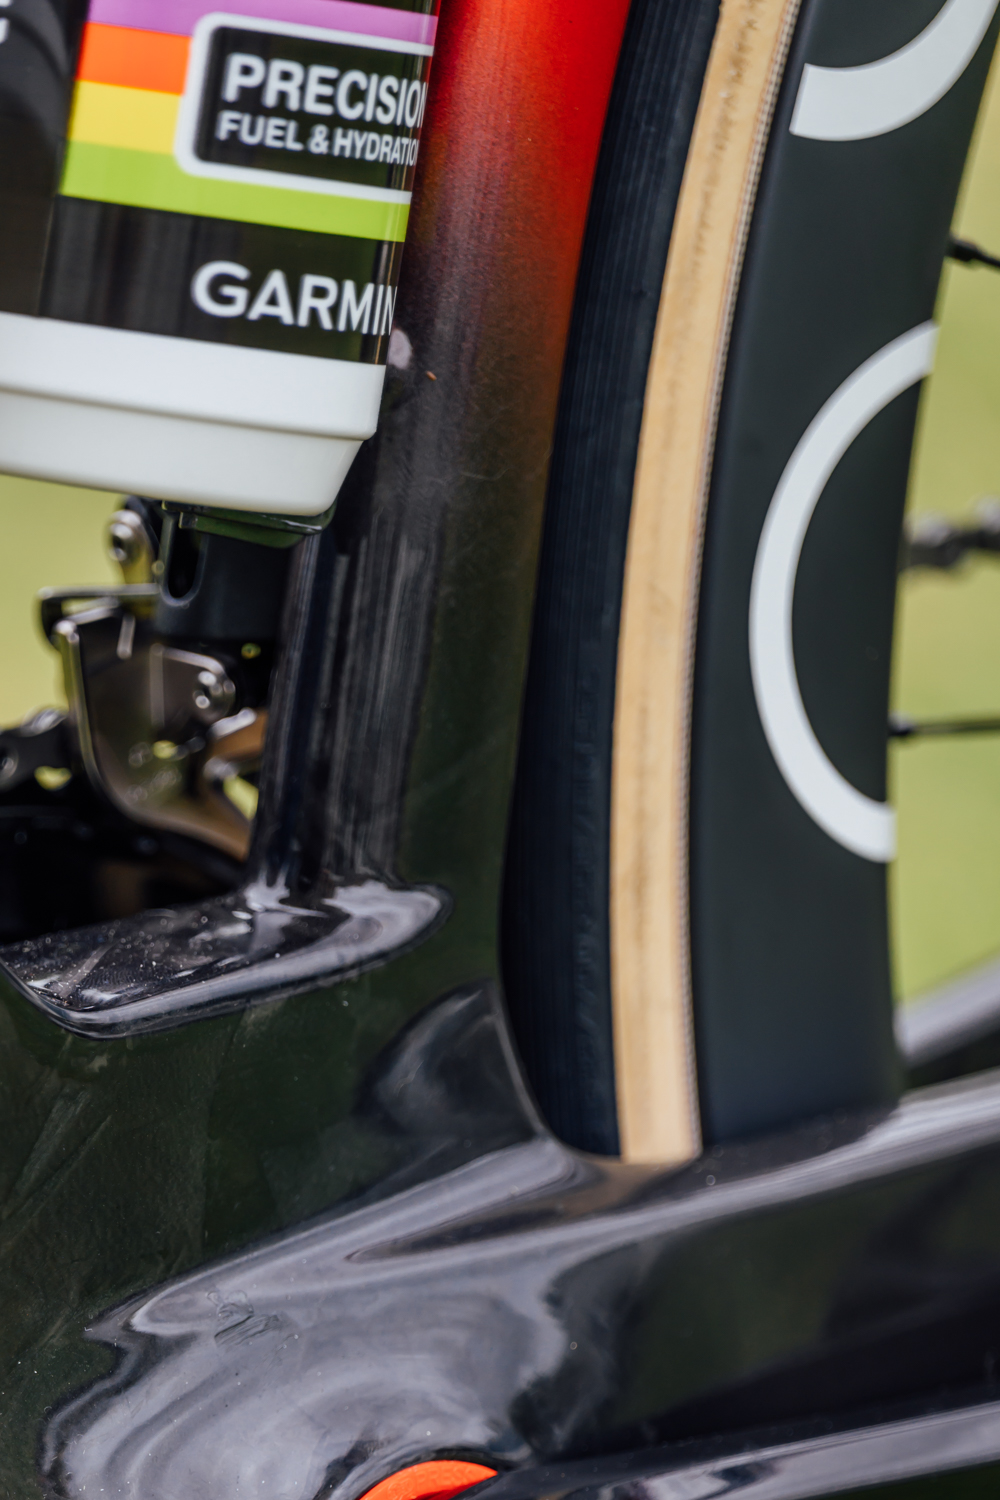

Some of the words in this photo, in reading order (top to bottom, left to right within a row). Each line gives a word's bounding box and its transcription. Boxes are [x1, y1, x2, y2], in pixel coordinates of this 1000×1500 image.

[215, 109, 304, 151] FUEL
[308, 123, 330, 155] &
[190, 259, 398, 336] GARMIN
